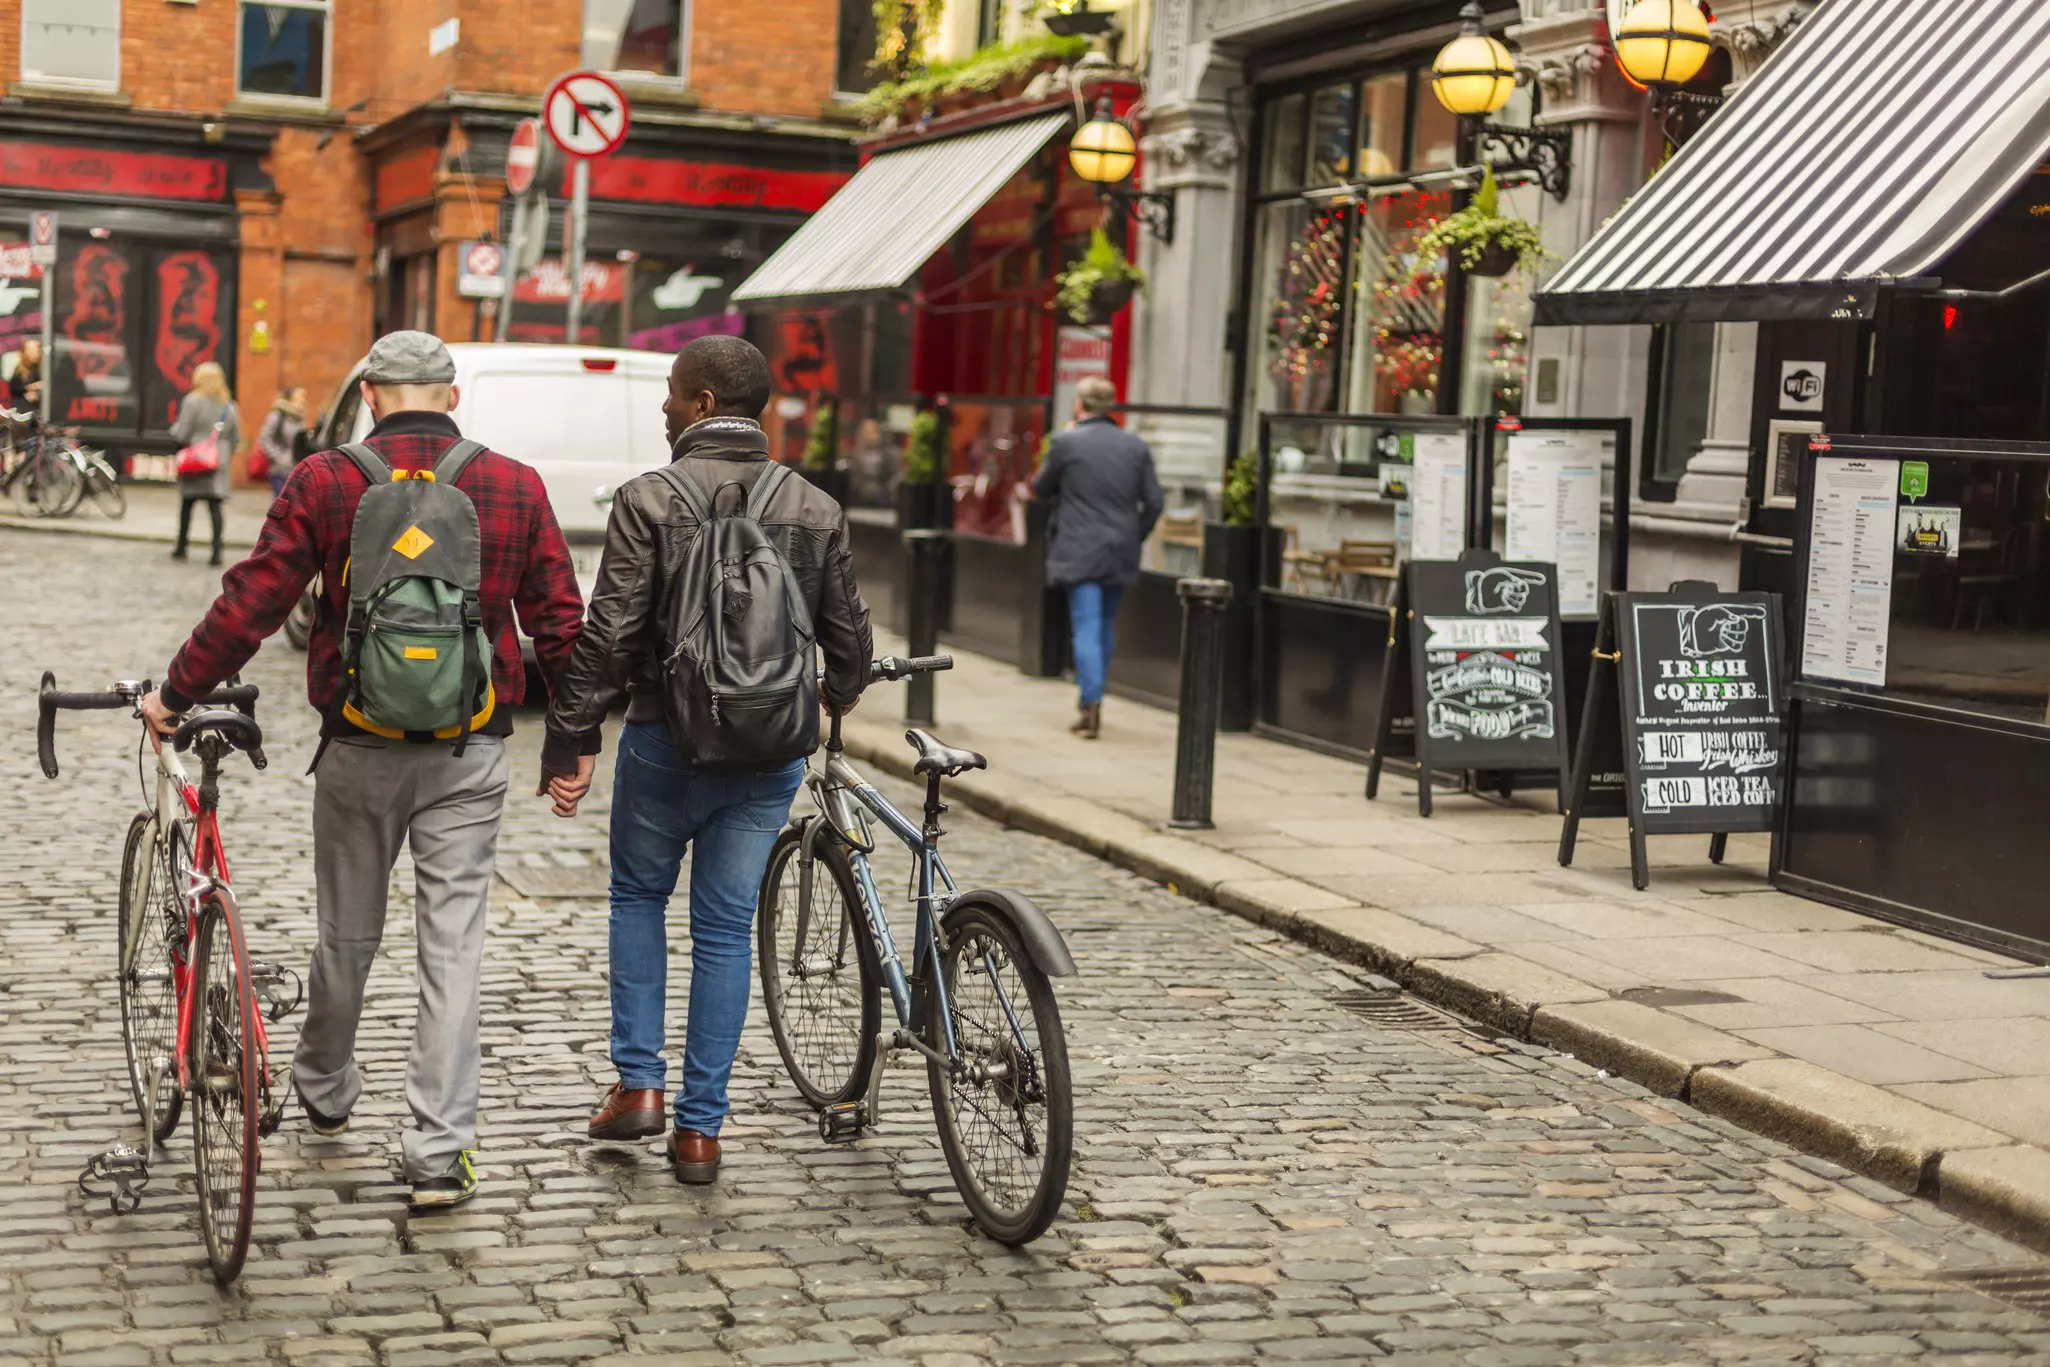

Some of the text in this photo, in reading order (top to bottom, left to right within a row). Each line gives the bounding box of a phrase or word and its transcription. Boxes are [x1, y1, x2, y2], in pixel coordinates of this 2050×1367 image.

[1658, 659, 1748, 678] IRISH
[1470, 710, 1511, 737] FOOD
[1659, 731, 1768, 758] HOT IRISH COFFEE
[1658, 776, 1770, 804] COLD ICED TEA
[1708, 789, 1741, 806] ICED
